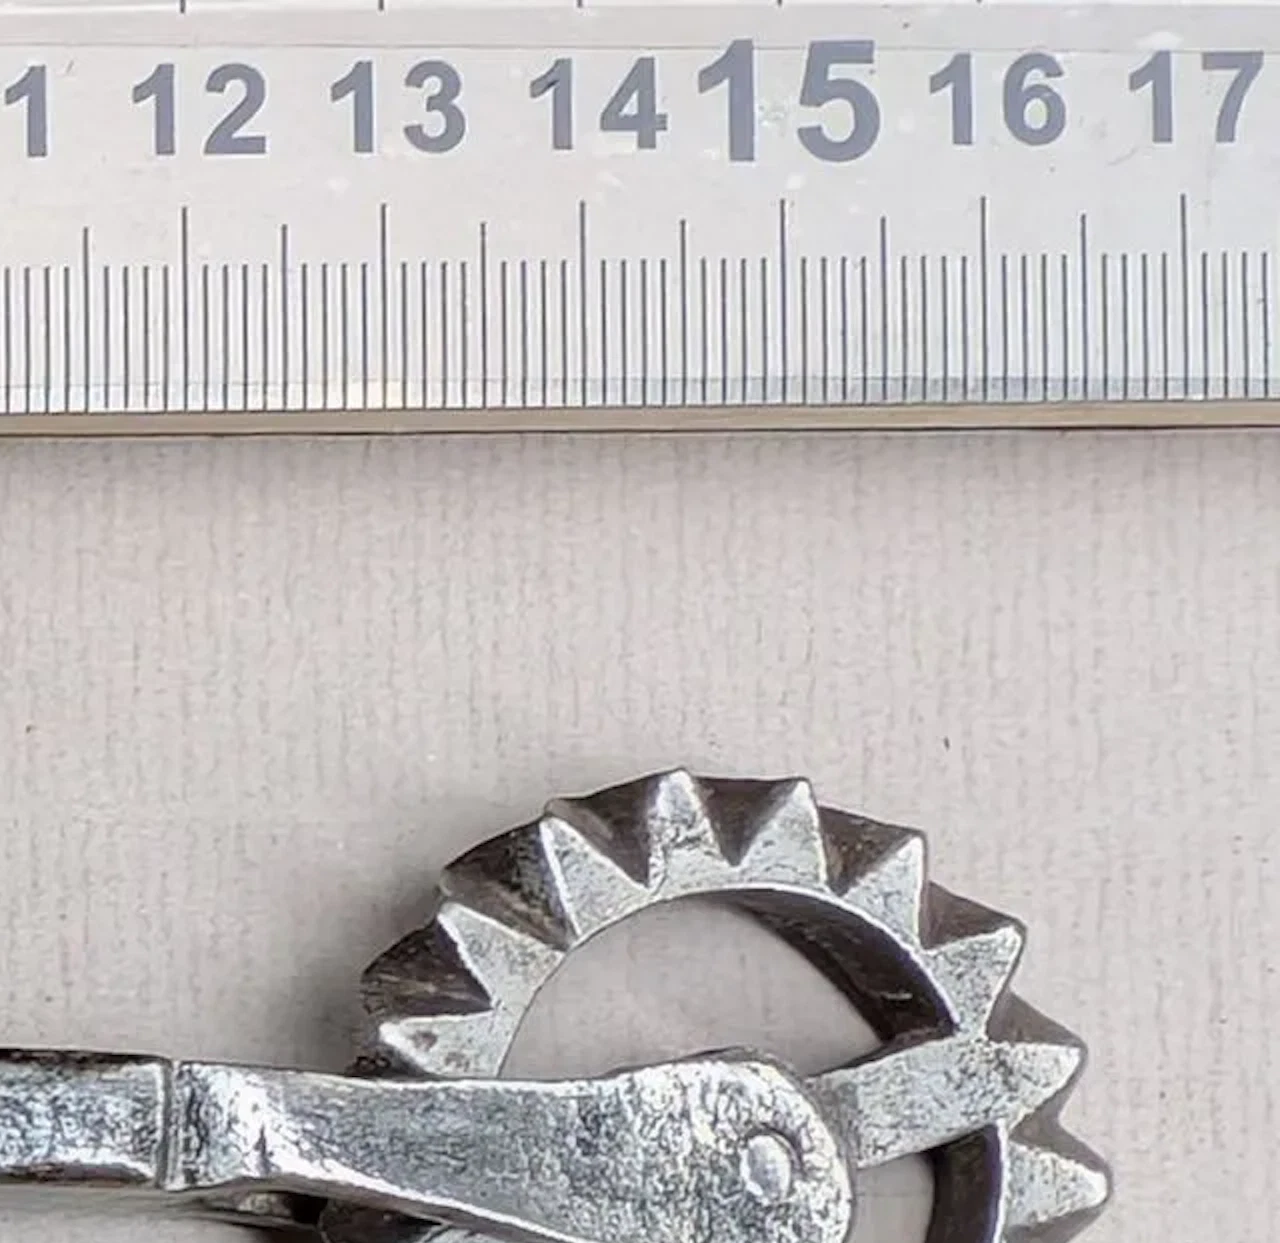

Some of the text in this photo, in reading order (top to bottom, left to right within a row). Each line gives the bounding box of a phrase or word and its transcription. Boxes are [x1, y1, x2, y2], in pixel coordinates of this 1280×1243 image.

[132, 63, 267, 156] 12
[331, 60, 464, 153] 13
[529, 57, 668, 150] 14
[697, 38, 882, 163] 15
[929, 53, 1067, 146] 16
[1128, 51, 1265, 144] 17
